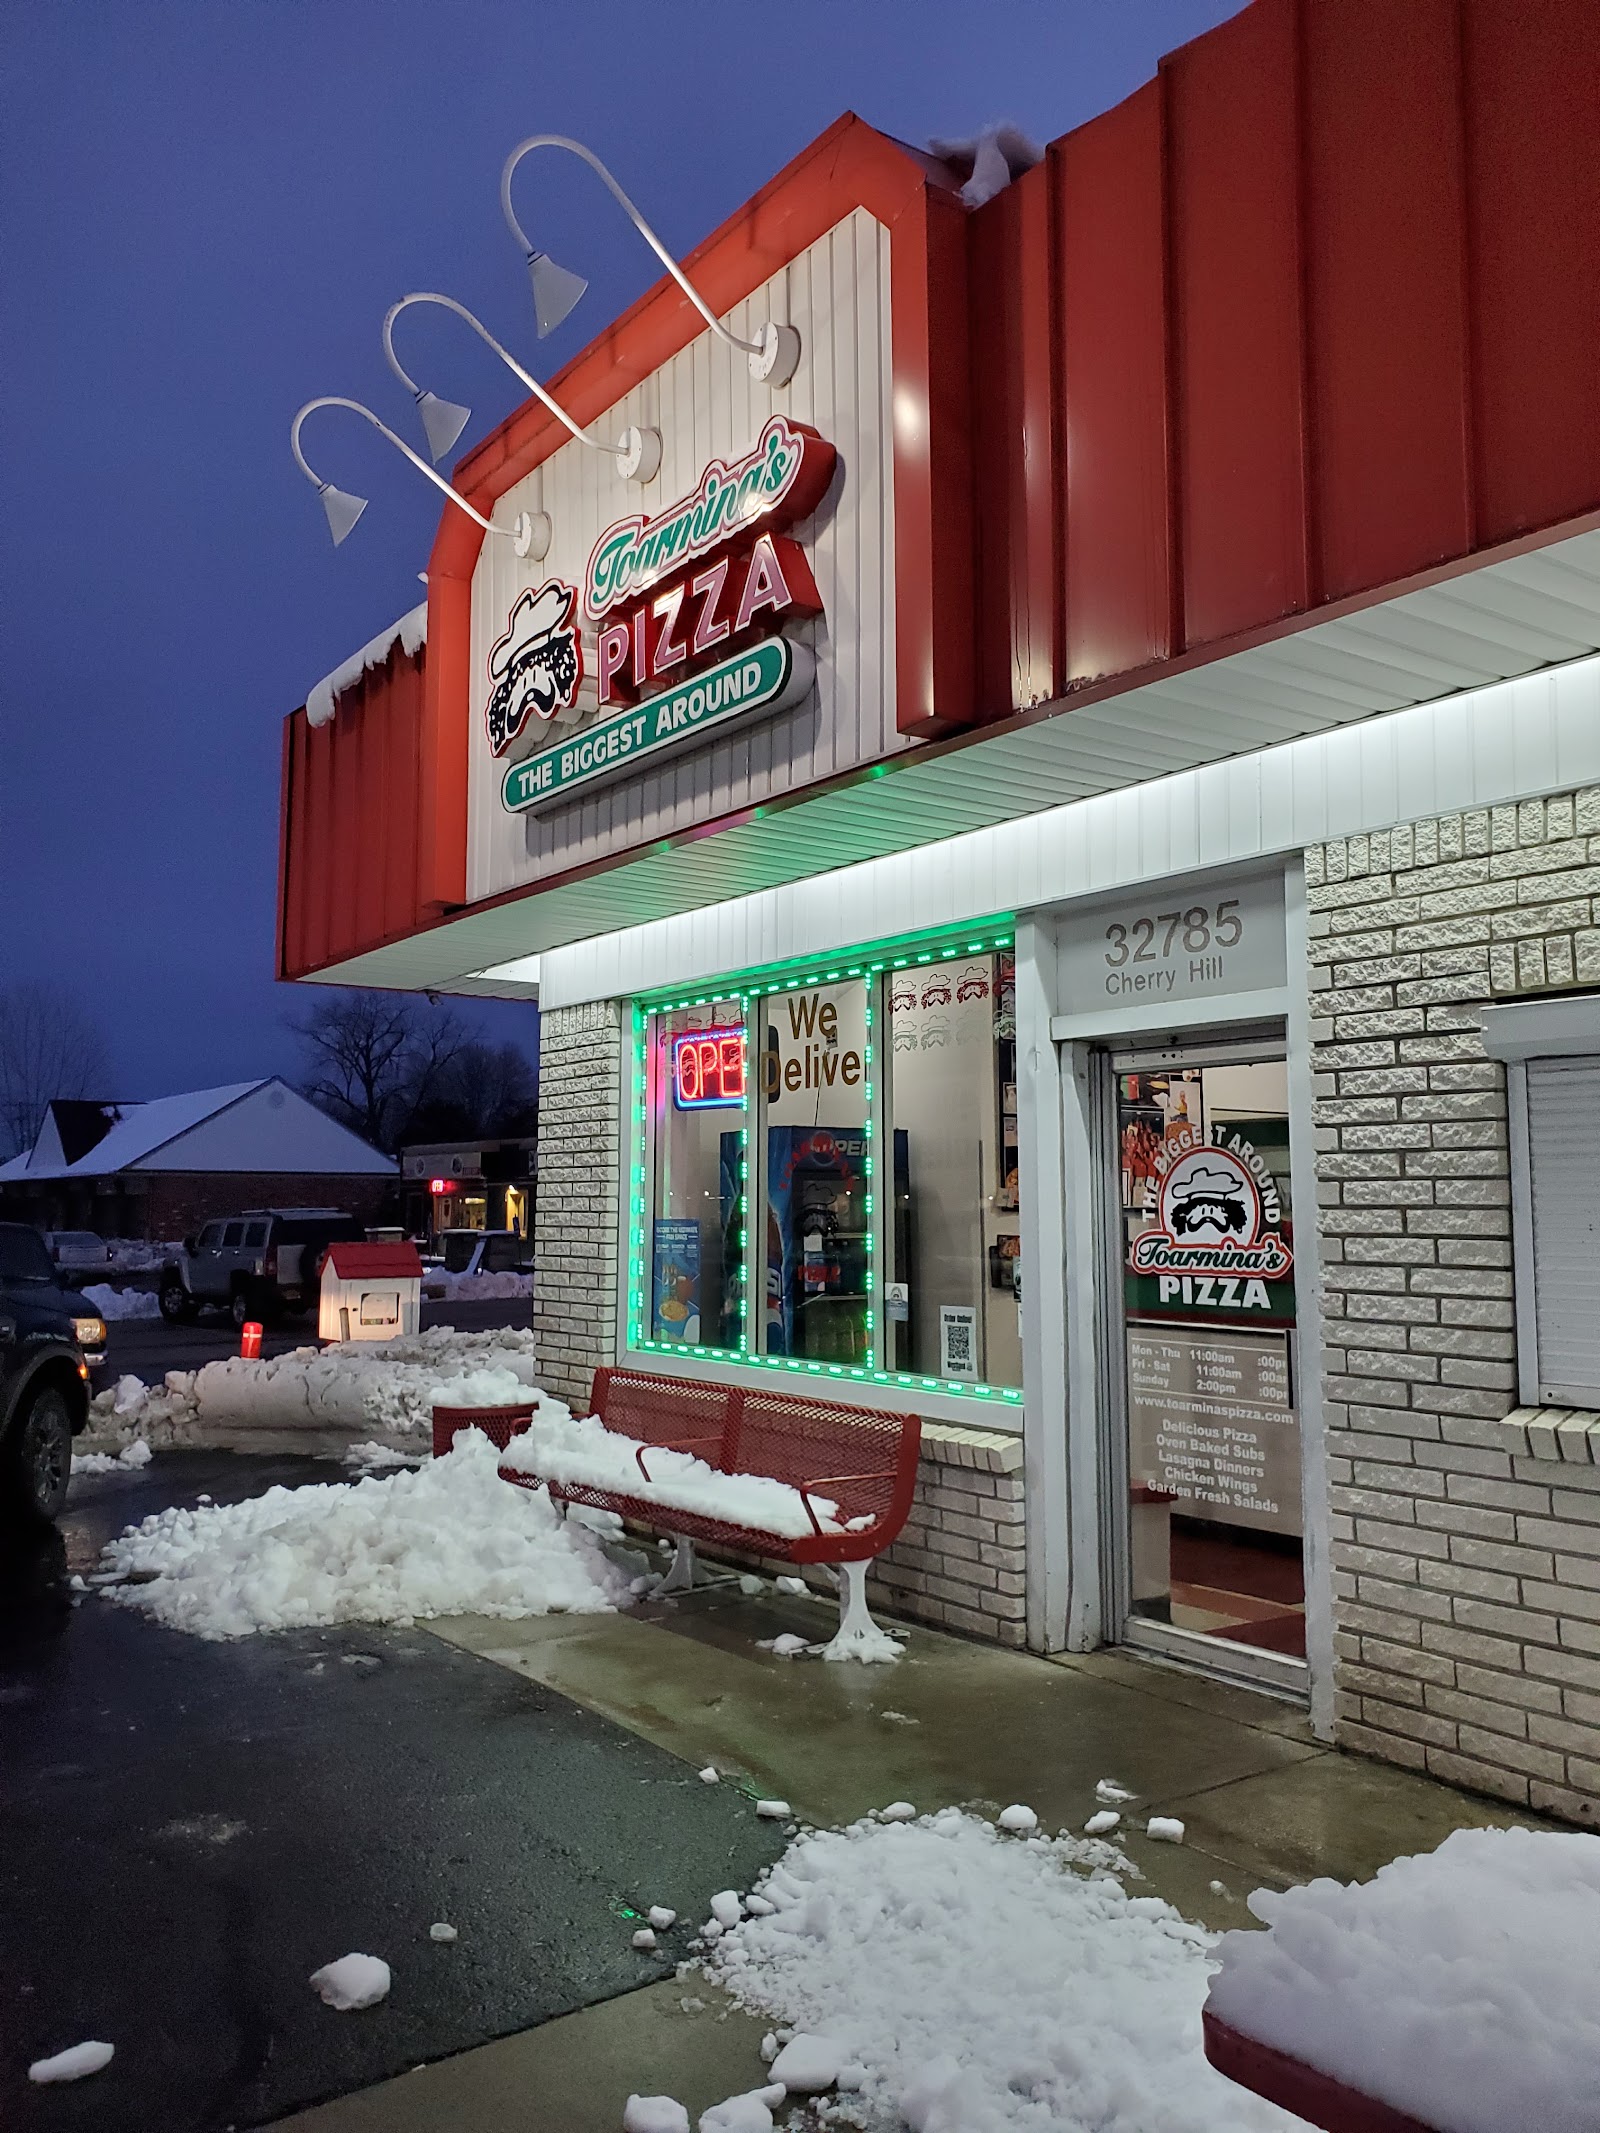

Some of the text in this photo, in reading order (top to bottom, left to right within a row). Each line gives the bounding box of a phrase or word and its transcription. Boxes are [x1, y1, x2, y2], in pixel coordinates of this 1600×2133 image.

[592, 433, 794, 605] Toarmina's
[598, 531, 793, 705] PIZZA
[518, 661, 762, 798] THE BIGGEST AROUND
[1105, 900, 1243, 967] 32785
[1105, 955, 1223, 995] Cherry Hill
[787, 993, 838, 1040] We
[680, 1037, 746, 1099] OPE
[761, 1043, 868, 1094] Delive
[1142, 1175, 1160, 1223] THE
[1227, 1133, 1281, 1224] AROUND
[1137, 1238, 1286, 1270] Toarmina's
[1159, 1275, 1272, 1309] PIZZA
[1131, 1344, 1152, 1356] Mon
[1161, 1346, 1181, 1359] Thu
[1189, 1349, 1235, 1364] 11:00am
[1132, 1358, 1145, 1370] Fri
[1153, 1360, 1171, 1372] Sat
[1196, 1364, 1242, 1379] 11:00am
[1132, 1373, 1170, 1389] Sunday
[1196, 1379, 1236, 1395] 2:00pm
[1134, 1395, 1294, 1425] www.toarminaspizza.com
[1156, 1433, 1266, 1462] Oven Baked Subs
[1162, 1418, 1257, 1444] Delicious Pizza
[1158, 1449, 1265, 1478] Lasagna Dinners
[1164, 1465, 1258, 1495] Chicken Wings
[1147, 1478, 1279, 1514] Garden Fresh Salads
